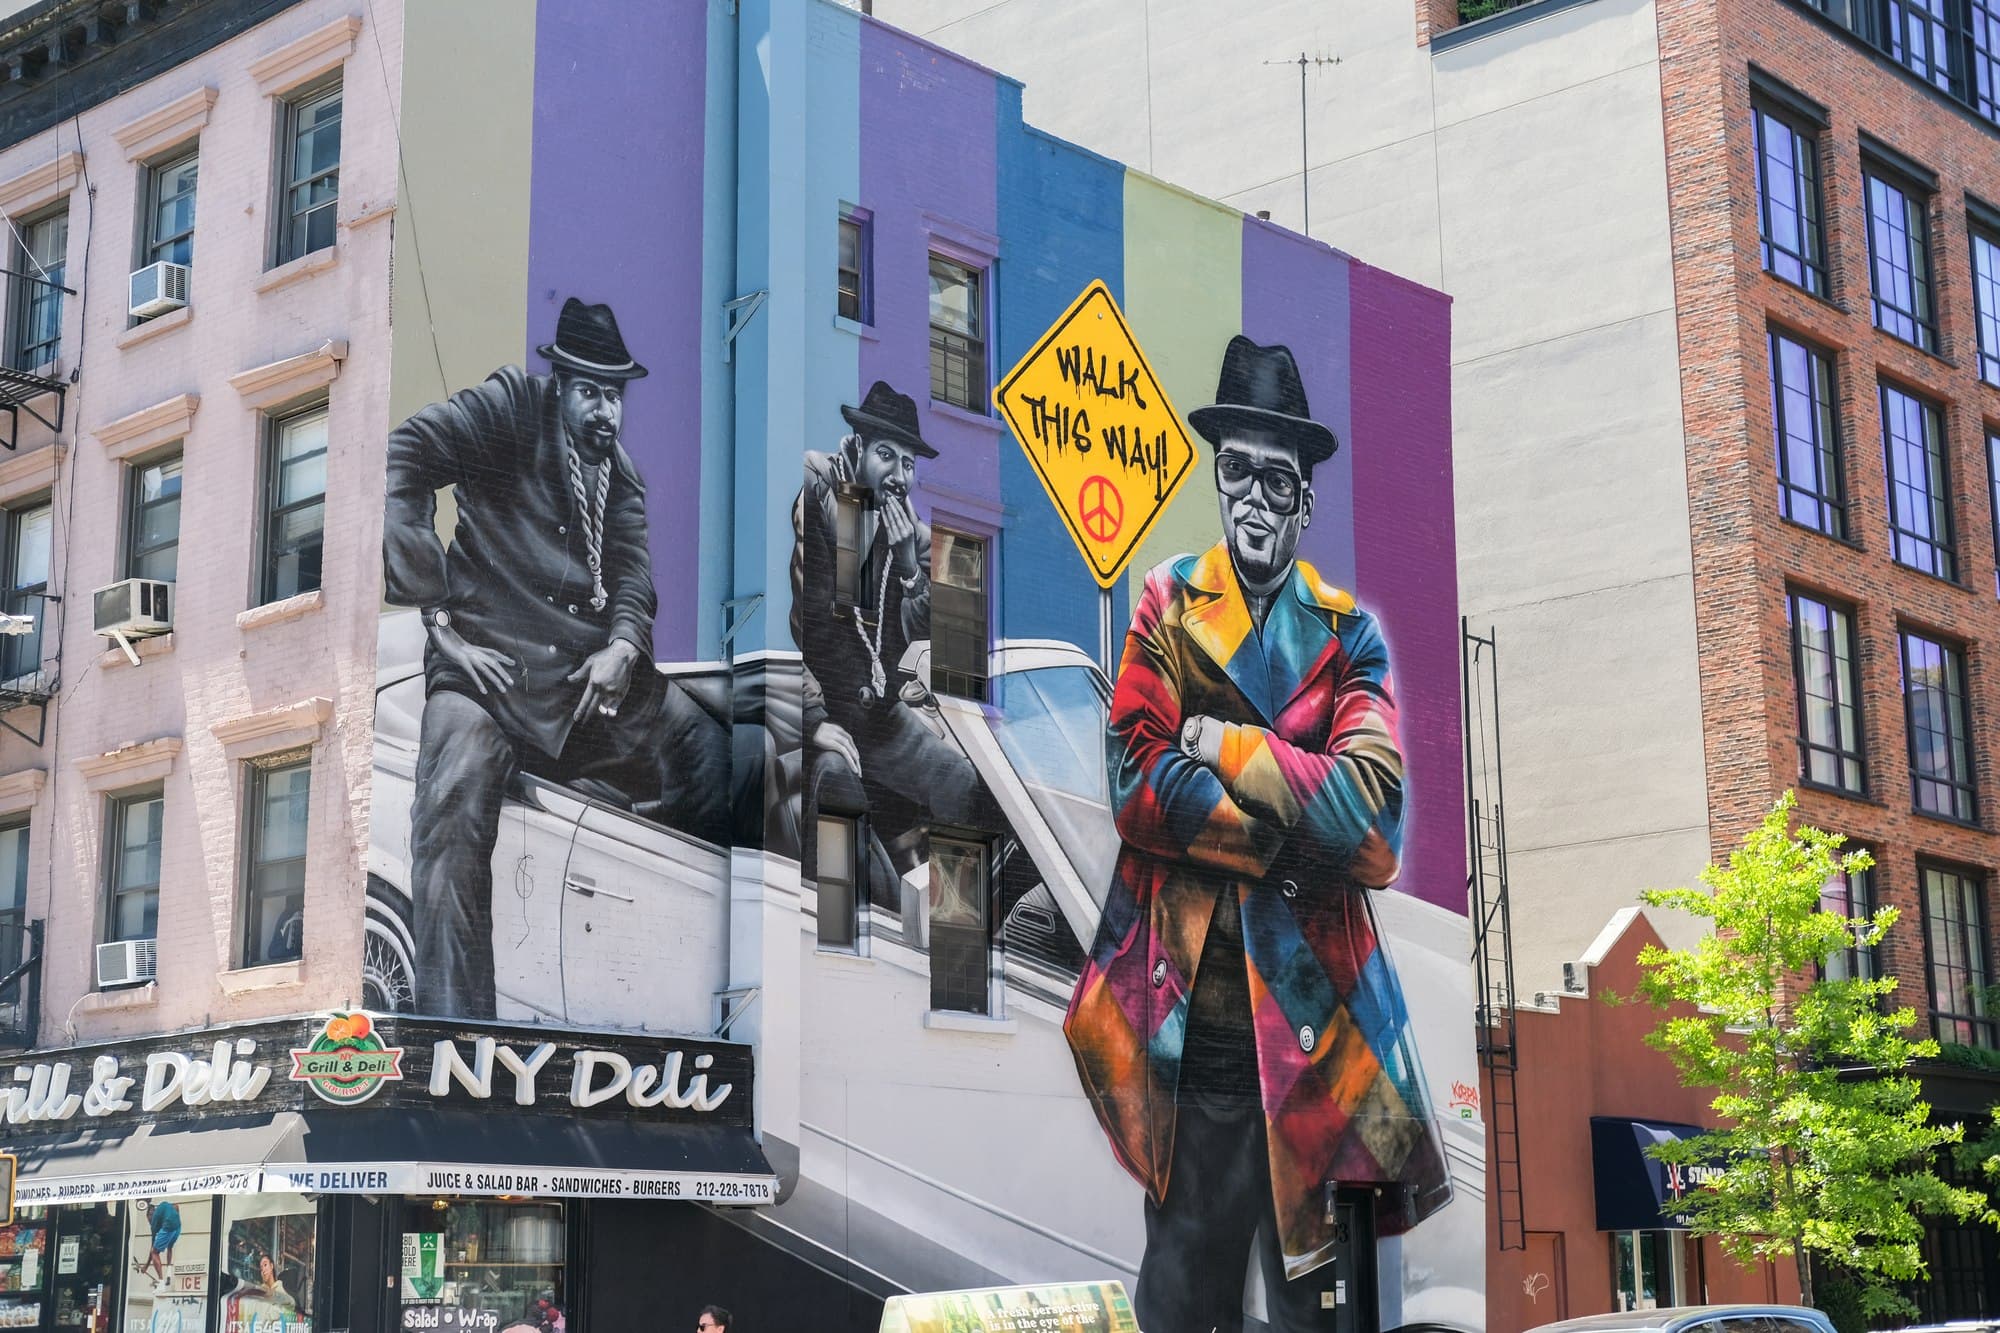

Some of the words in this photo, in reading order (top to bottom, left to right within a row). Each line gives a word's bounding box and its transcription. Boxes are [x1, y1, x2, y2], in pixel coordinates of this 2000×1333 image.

[1056, 345, 1147, 410] WALK
[1020, 393, 1093, 456] THIS
[1101, 424, 1169, 502] WAY!
[339, 1053, 353, 1061] NY
[307, 1061, 338, 1073] Grill
[342, 1061, 353, 1072] &
[358, 1060, 386, 1072] Deli
[429, 1036, 556, 1106] NY
[570, 1051, 732, 1112] Deli
[84, 1056, 136, 1117] &
[142, 1038, 272, 1112] Deli
[322, 1080, 369, 1096] GOURMET
[289, 1173, 313, 1189] WE
[320, 1171, 388, 1188] DELIVER
[427, 1172, 461, 1189] JUICE
[465, 1173, 473, 1189] &
[477, 1173, 512, 1190] SALAD
[516, 1175, 538, 1192] BAR
[551, 1177, 622, 1194] SANDWICHES
[633, 1180, 681, 1196] BURGERS
[696, 1182, 769, 1198] 212-228-7878
[182, 1276, 201, 1290] ICE
[998, 1306, 1030, 1317] fresh
[1032, 1302, 1099, 1318] perspective
[404, 1308, 439, 1328] Salad
[458, 1308, 497, 1333] Wrap
[990, 1321, 1000, 1331] is
[1003, 1320, 1015, 1330] in
[1017, 1318, 1037, 1329] the
[1040, 1317, 1059, 1328] eye
[1062, 1315, 1074, 1325] of
[1076, 1313, 1095, 1324] the
